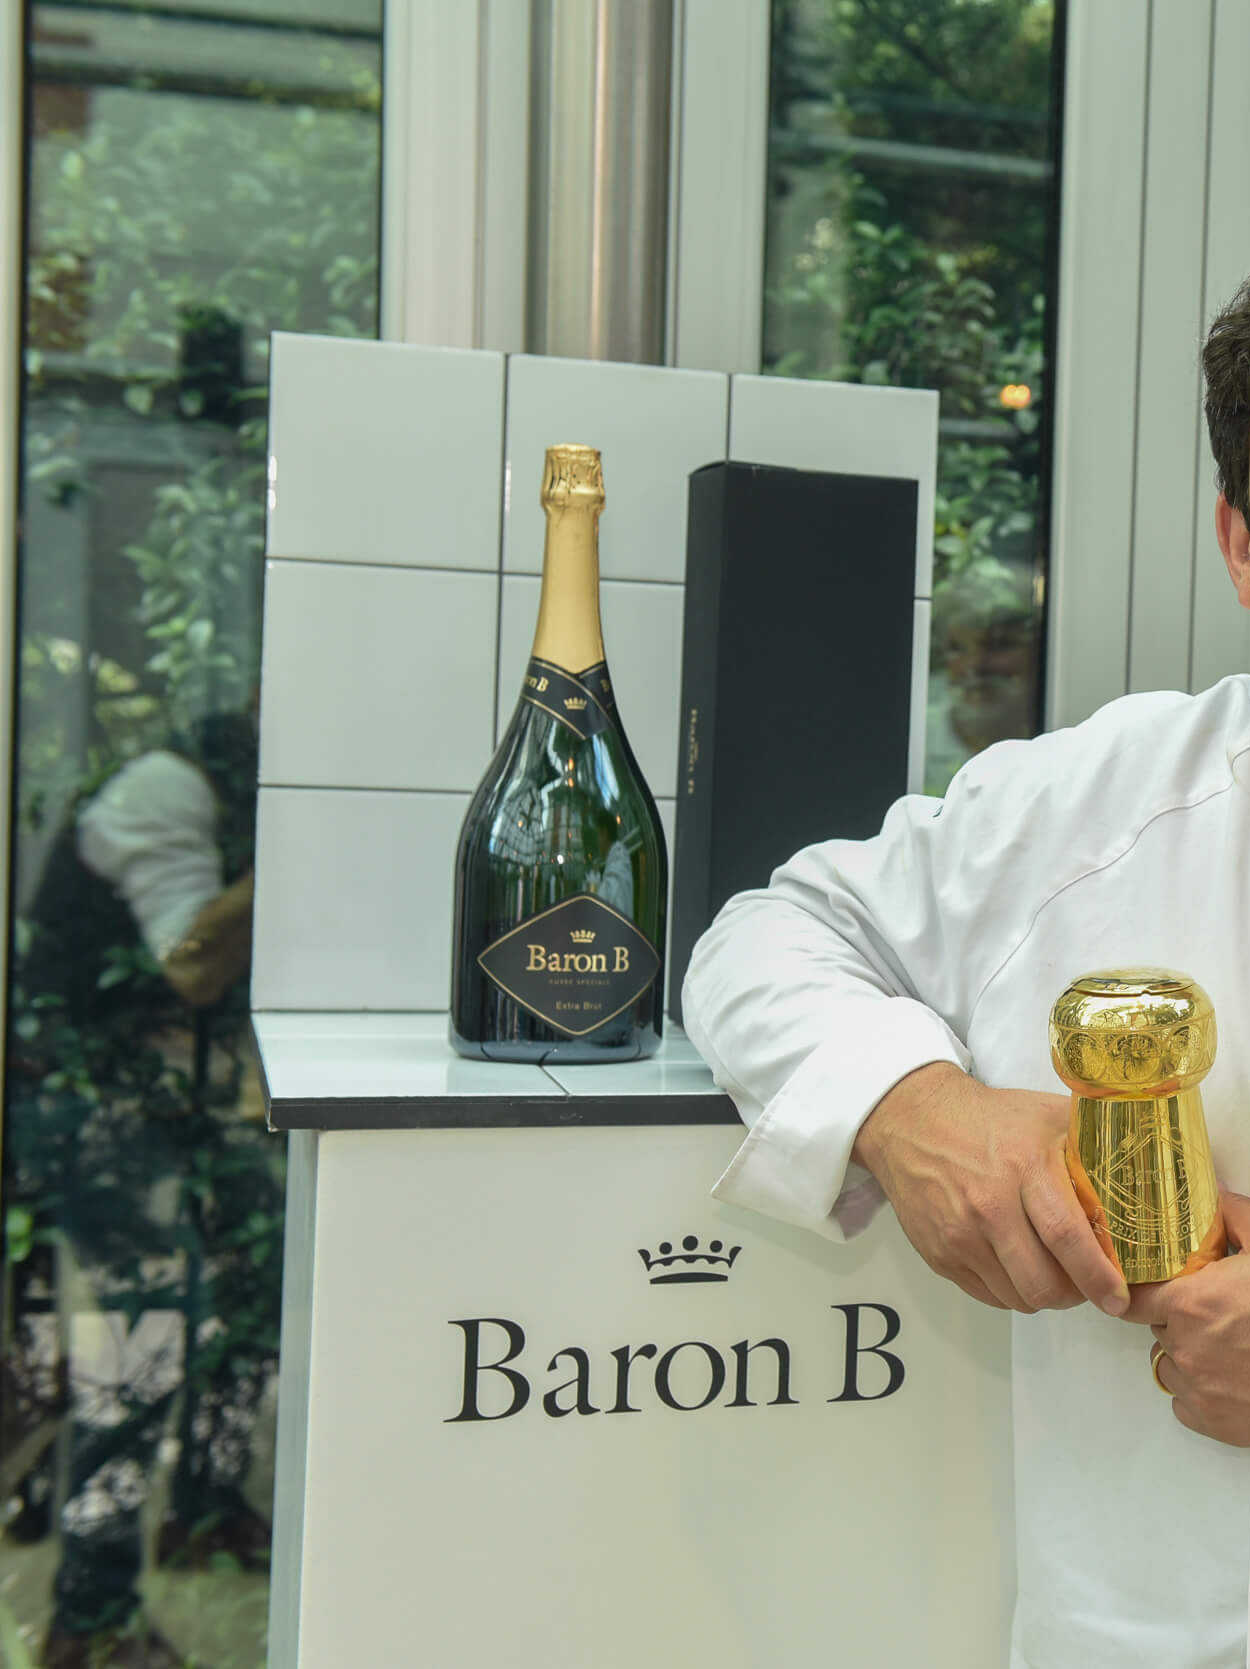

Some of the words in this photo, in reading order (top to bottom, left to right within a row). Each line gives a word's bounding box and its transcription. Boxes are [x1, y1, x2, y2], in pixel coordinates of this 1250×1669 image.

[526, 944, 608, 972] Baron
[612, 946, 630, 973] B
[555, 1001, 580, 1010] Extra
[583, 1001, 602, 1010] Brut
[1111, 1220, 1138, 1240] PRIX
[443, 1317, 800, 1423] Baron
[826, 1302, 906, 1403] B
